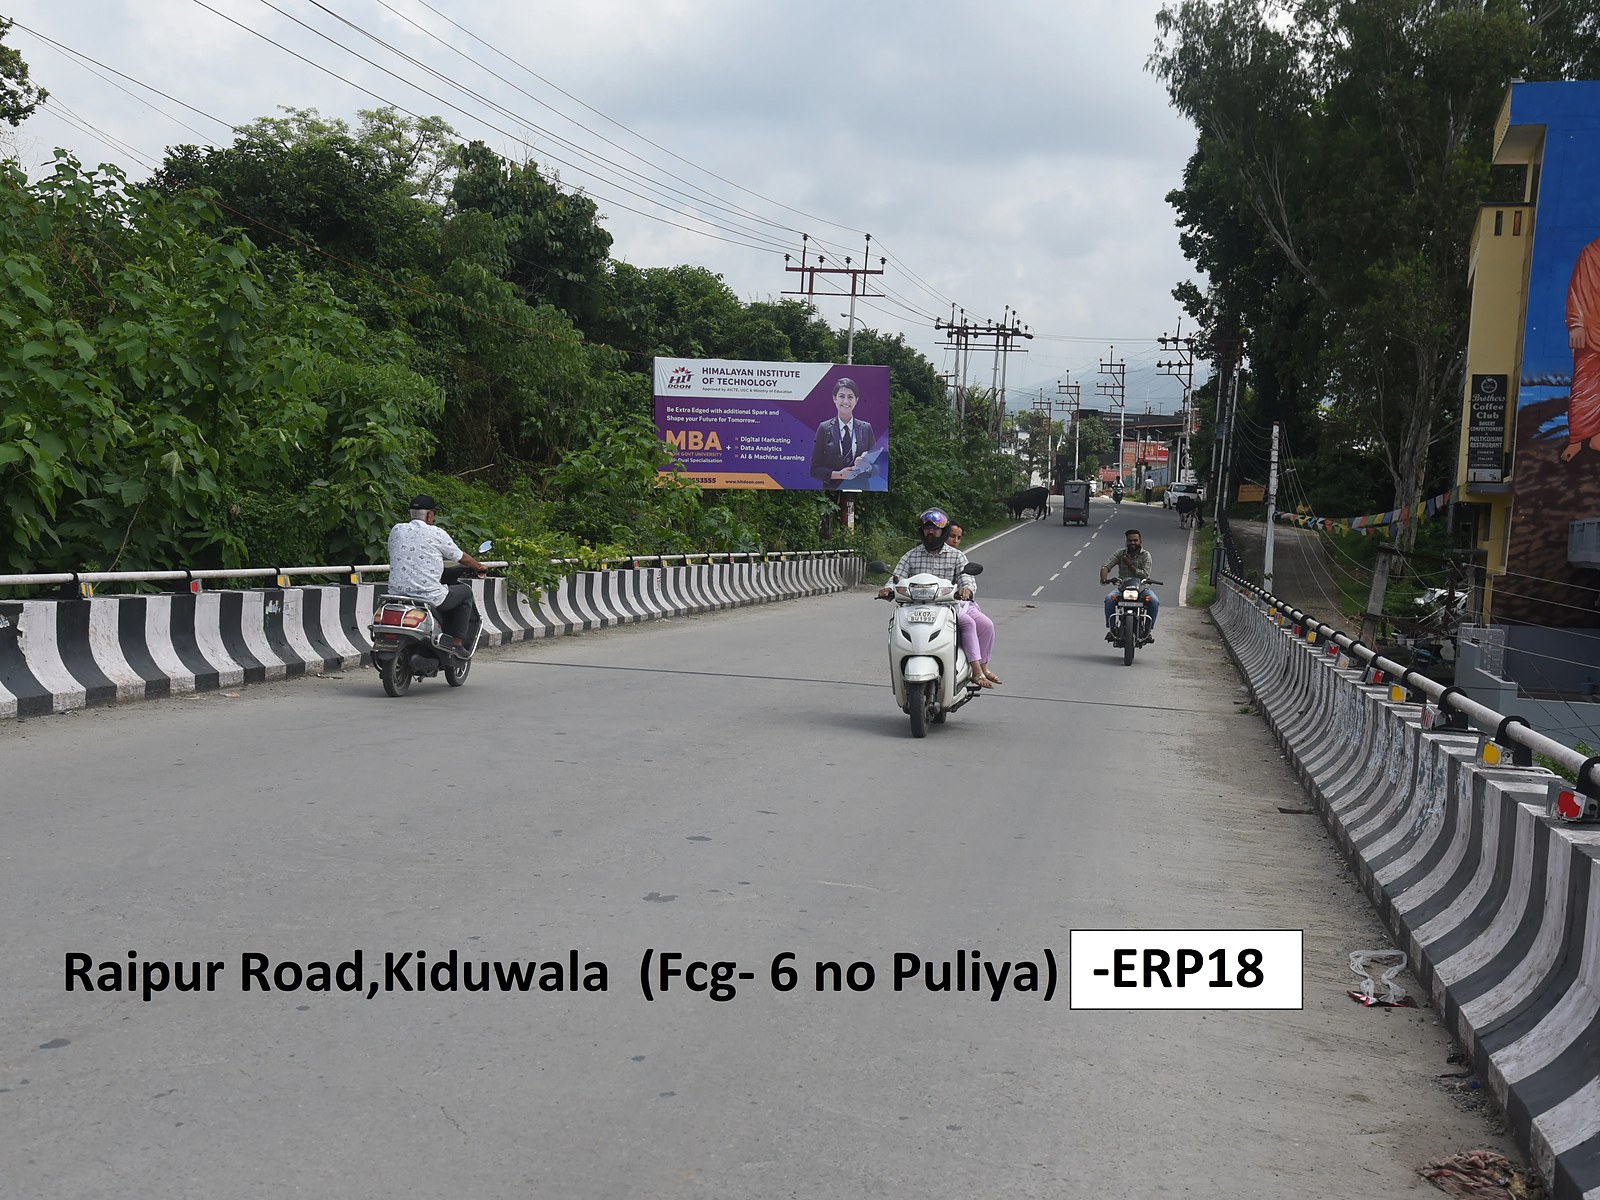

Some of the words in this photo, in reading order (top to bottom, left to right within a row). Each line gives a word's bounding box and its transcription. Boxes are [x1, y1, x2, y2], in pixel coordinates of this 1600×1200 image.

[702, 367, 754, 376] HIMALAYAN
[757, 369, 801, 378] INSTITUTE
[669, 374, 694, 383] HIT
[702, 377, 715, 385] OF
[717, 377, 778, 387] TECHNOLOGY
[1472, 394, 1506, 402] Brothers
[666, 430, 722, 451] MBA
